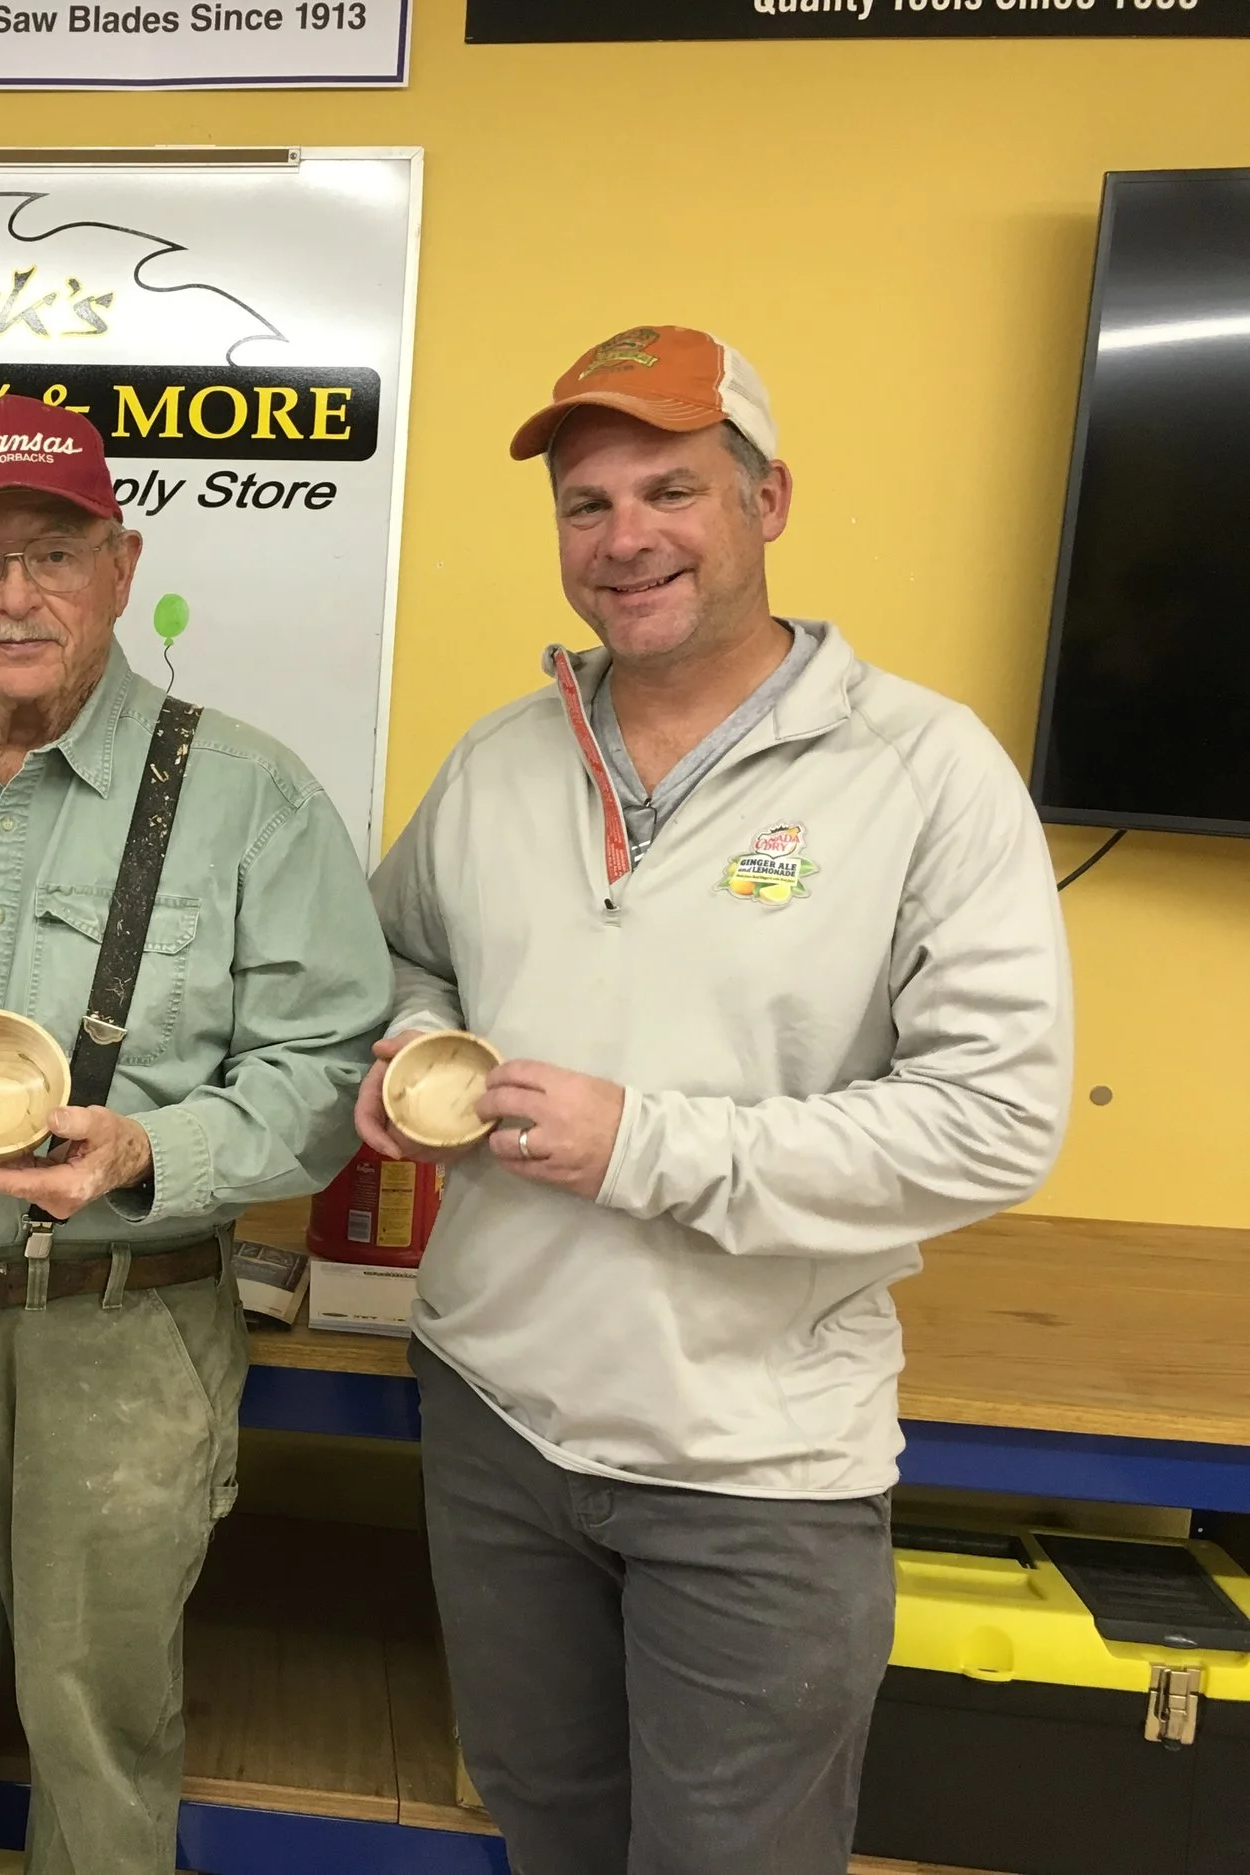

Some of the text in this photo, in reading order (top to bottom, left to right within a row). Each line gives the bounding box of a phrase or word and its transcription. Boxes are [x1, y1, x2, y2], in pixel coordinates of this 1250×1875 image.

[69, 5, 180, 33] Blades
[190, 3, 284, 32] Since
[295, 2, 366, 30] 1913
[111, 385, 352, 440] MORE
[197, 471, 337, 510] Store
[740, 859, 797, 871] GINGER ALE
[752, 866, 796, 877] LEMONADE
